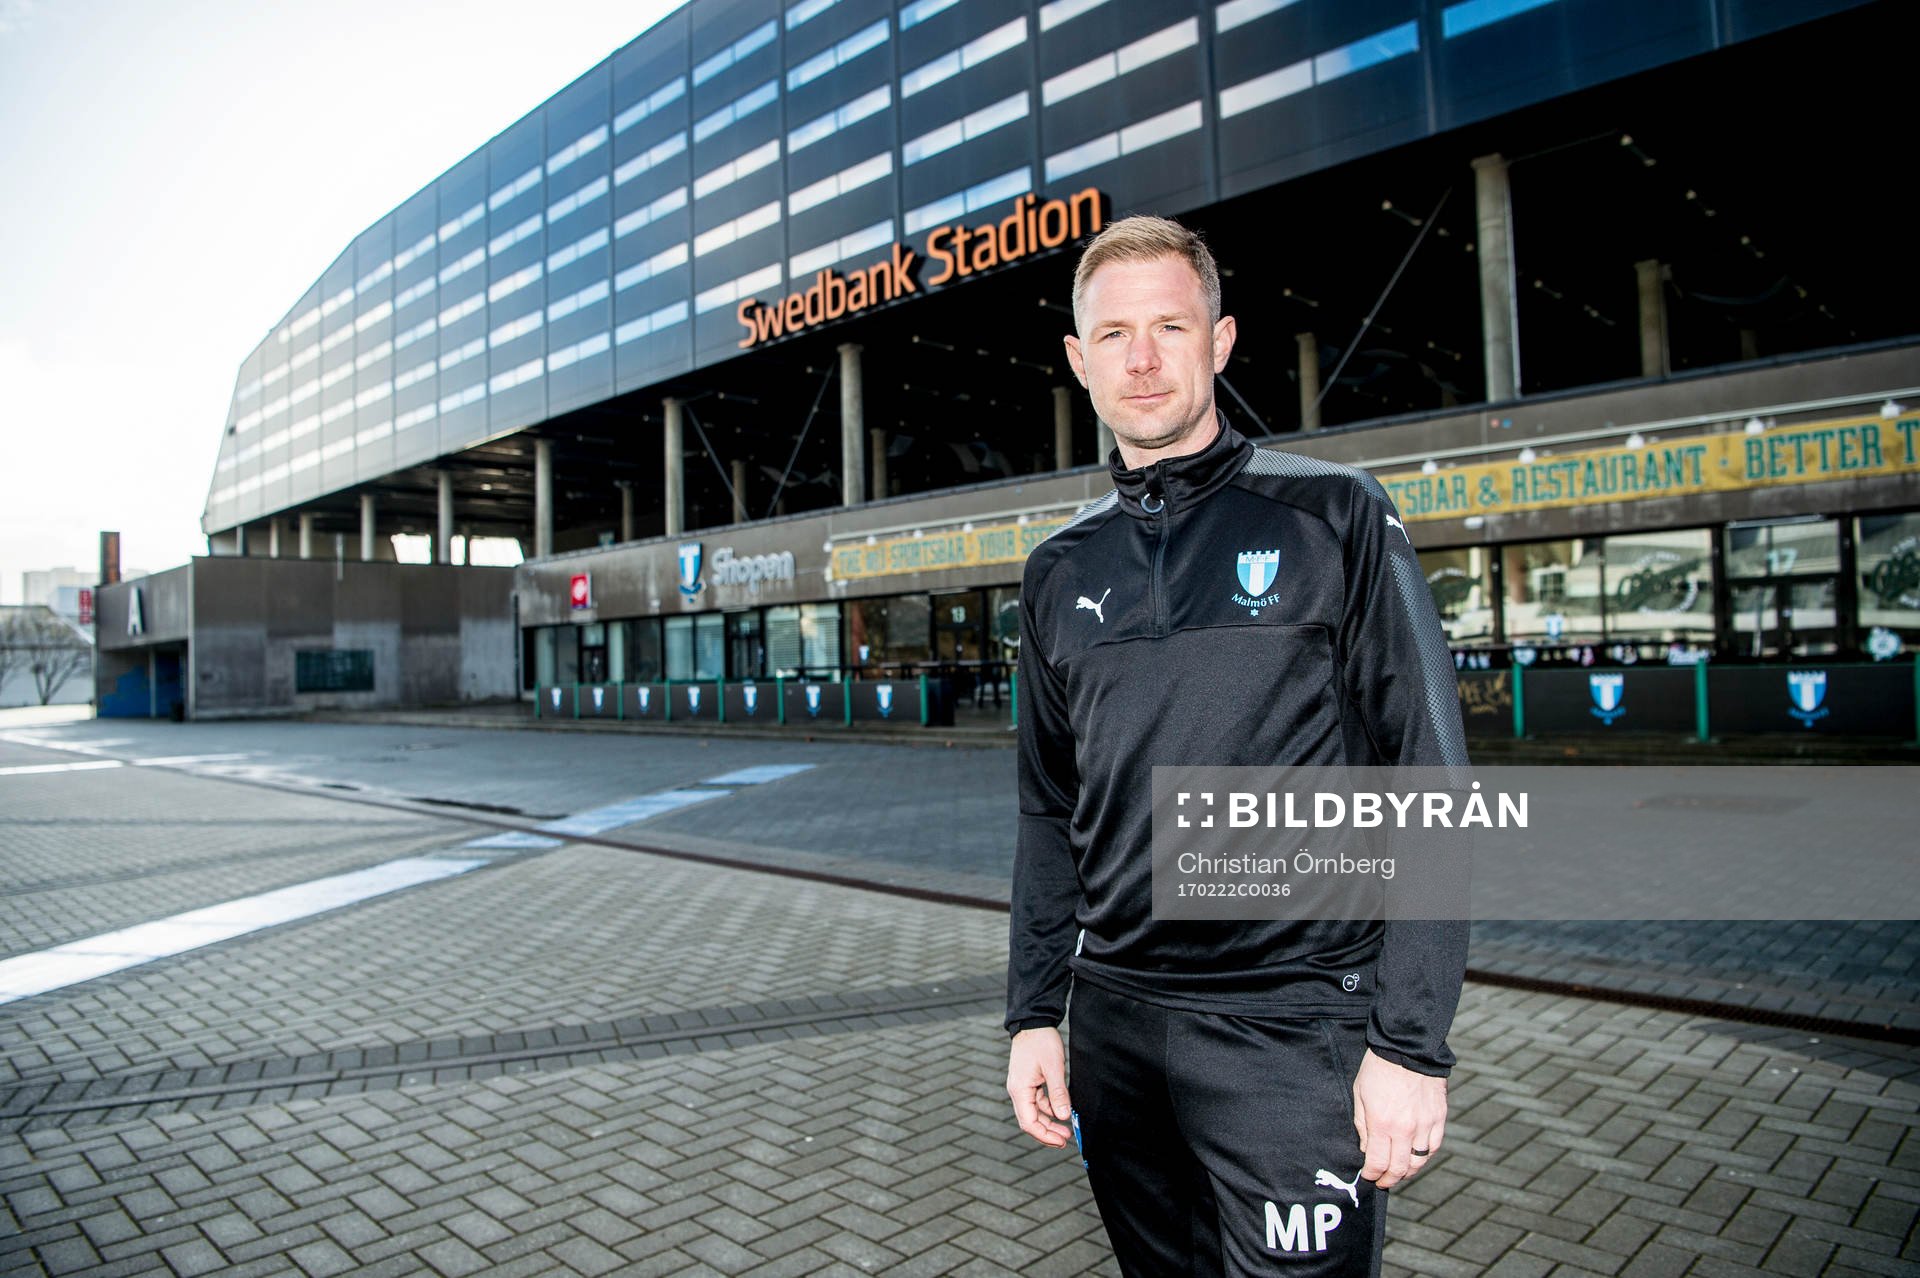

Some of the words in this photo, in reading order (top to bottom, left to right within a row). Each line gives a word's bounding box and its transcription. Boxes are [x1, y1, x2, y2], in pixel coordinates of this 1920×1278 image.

[737, 242, 917, 348] Swedbank
[926, 187, 1102, 287] Stadion
[1386, 473, 1469, 515] TSBAR
[1478, 475, 1503, 507] &
[1511, 445, 1707, 505] RESTAURANT
[1744, 423, 1884, 480] BETTER
[711, 546, 797, 593] Shopen
[890, 535, 967, 570] SPORTSBAR
[976, 528, 1016, 560] YOUR
[1767, 548, 1798, 573] 17
[127, 585, 143, 637] A
[1231, 593, 1267, 607] Malmö
[1267, 593, 1280, 605] FF
[1264, 1200, 1343, 1252] MP
